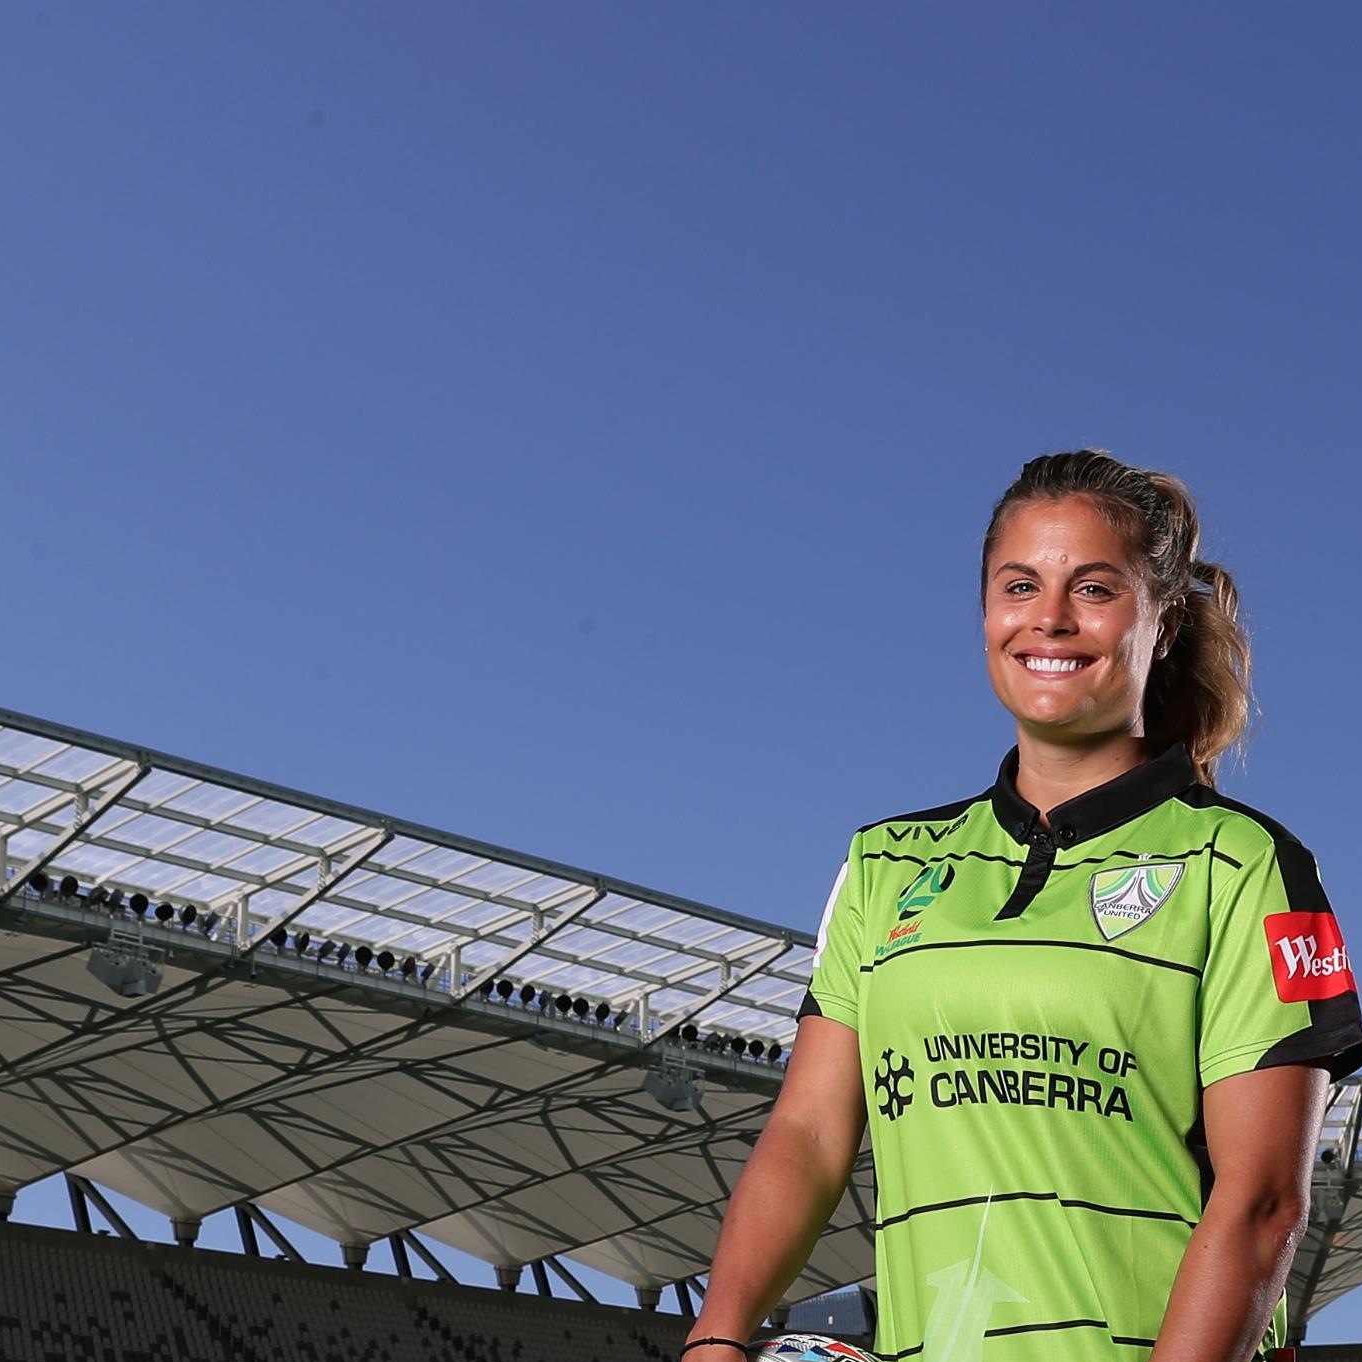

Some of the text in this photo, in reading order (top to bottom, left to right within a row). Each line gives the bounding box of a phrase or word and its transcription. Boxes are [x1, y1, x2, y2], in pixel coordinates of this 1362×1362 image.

[1094, 902, 1153, 915] CANBERRA
[1103, 910, 1141, 920] UNITED
[924, 1032, 1089, 1066] UNIVERSITY
[1098, 1047, 1138, 1078] OF
[930, 1069, 1134, 1122] CANBERRA
